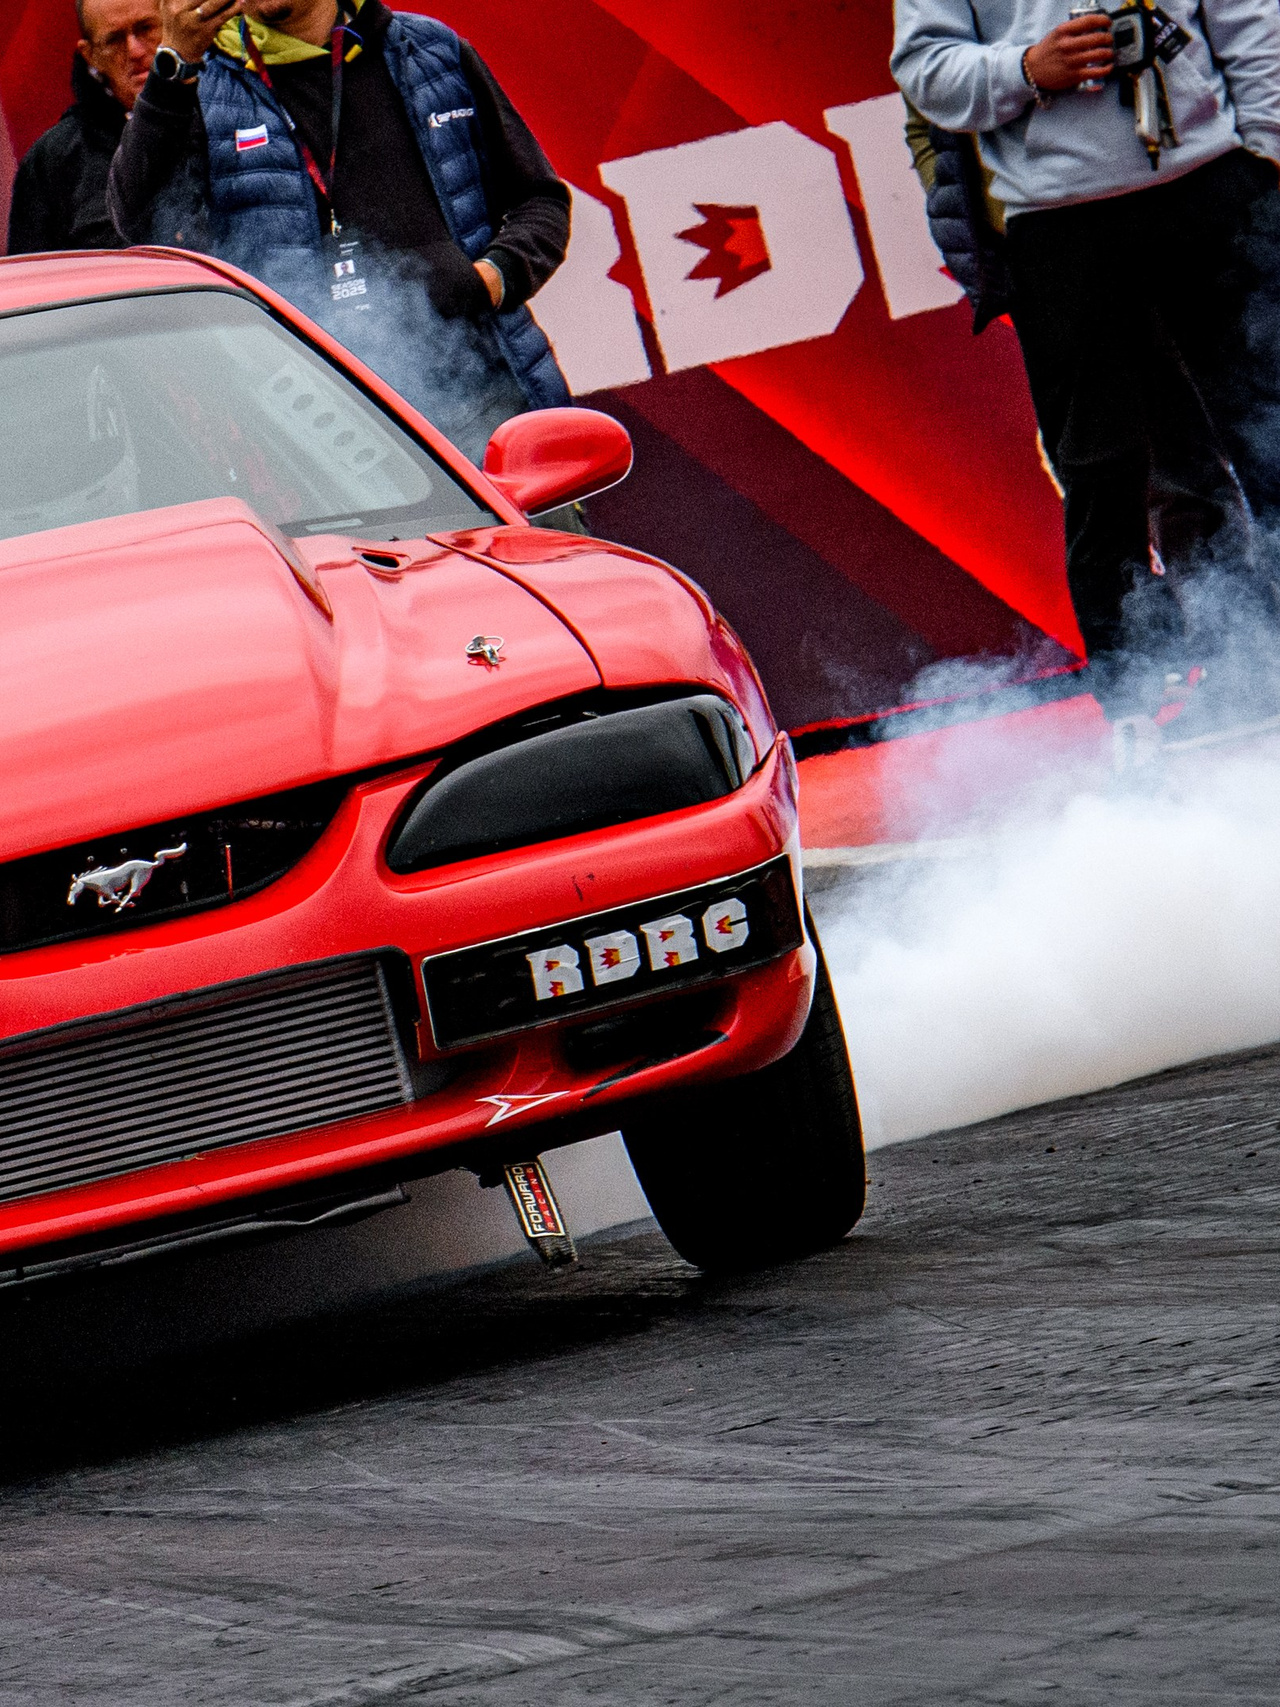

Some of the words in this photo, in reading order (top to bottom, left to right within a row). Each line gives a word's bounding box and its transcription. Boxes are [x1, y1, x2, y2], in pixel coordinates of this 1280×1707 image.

[332, 285, 367, 301] 2025
[525, 897, 750, 1001] RDRC
[511, 1166, 546, 1233] FORWARD
[526, 1167, 556, 1229] RACING
